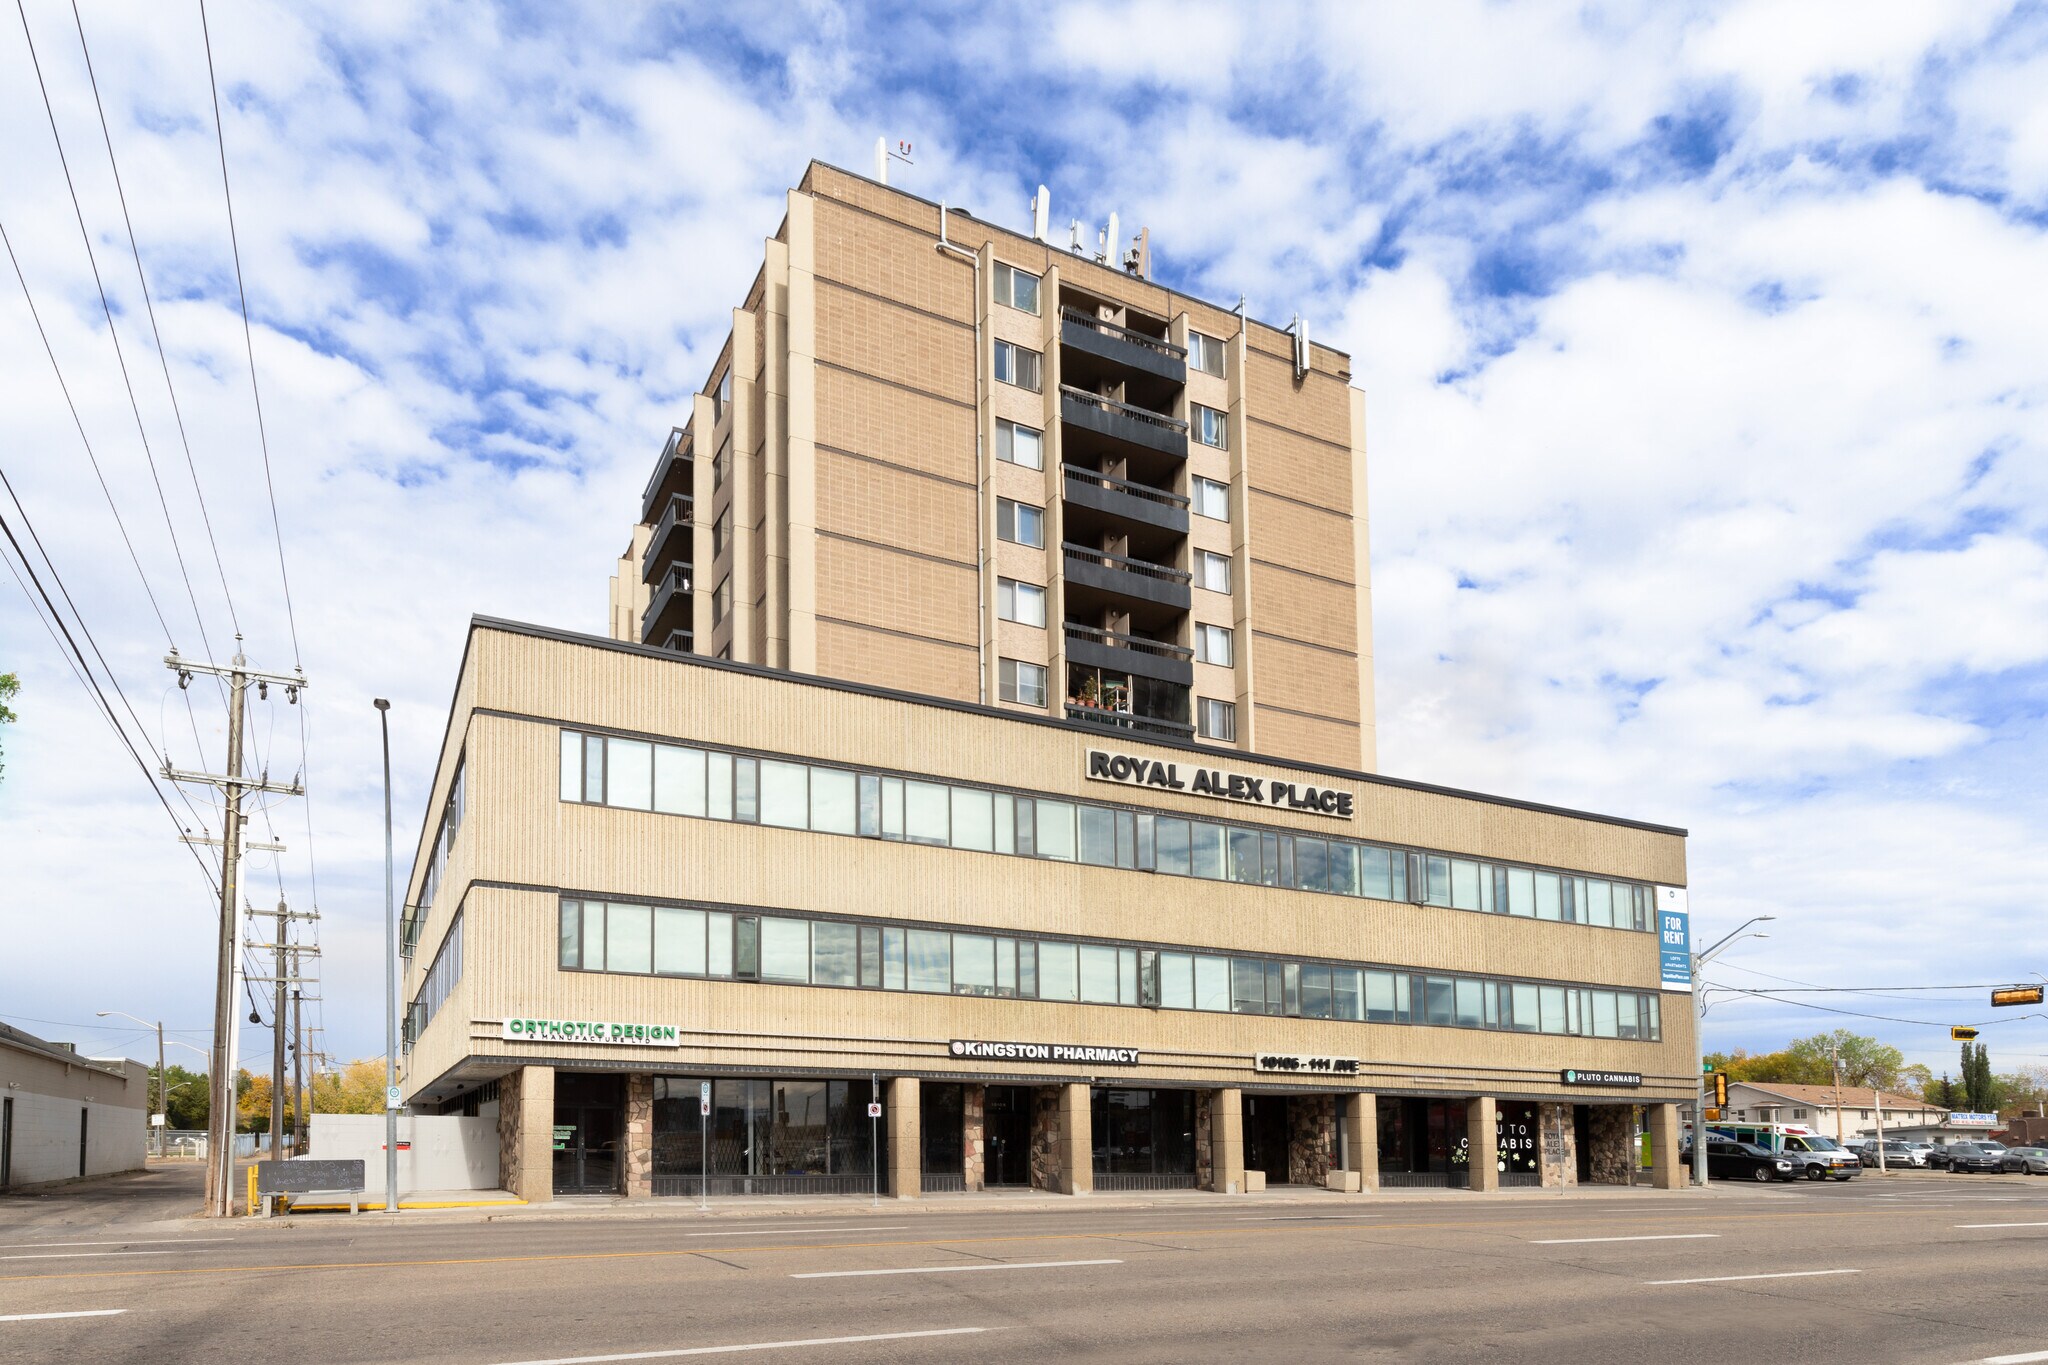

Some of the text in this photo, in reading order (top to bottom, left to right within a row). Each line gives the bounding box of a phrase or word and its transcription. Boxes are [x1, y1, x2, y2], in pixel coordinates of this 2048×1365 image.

[1090, 750, 1354, 816] ROYAL ALEX PLACE
[1665, 916, 1682, 930] FOR
[1663, 930, 1685, 945] RENT
[510, 1019, 675, 1040] ORTHOTIC DESIGN
[542, 1034, 625, 1043] MANUFACTURE
[1053, 1046, 1139, 1063] PHARMACY
[1333, 1059, 1360, 1072] AVE
[1577, 1073, 1640, 1083] PLUTO CANNABIS
[1496, 1124, 1527, 1135] UTO
[1461, 1137, 1533, 1149] CABIS
